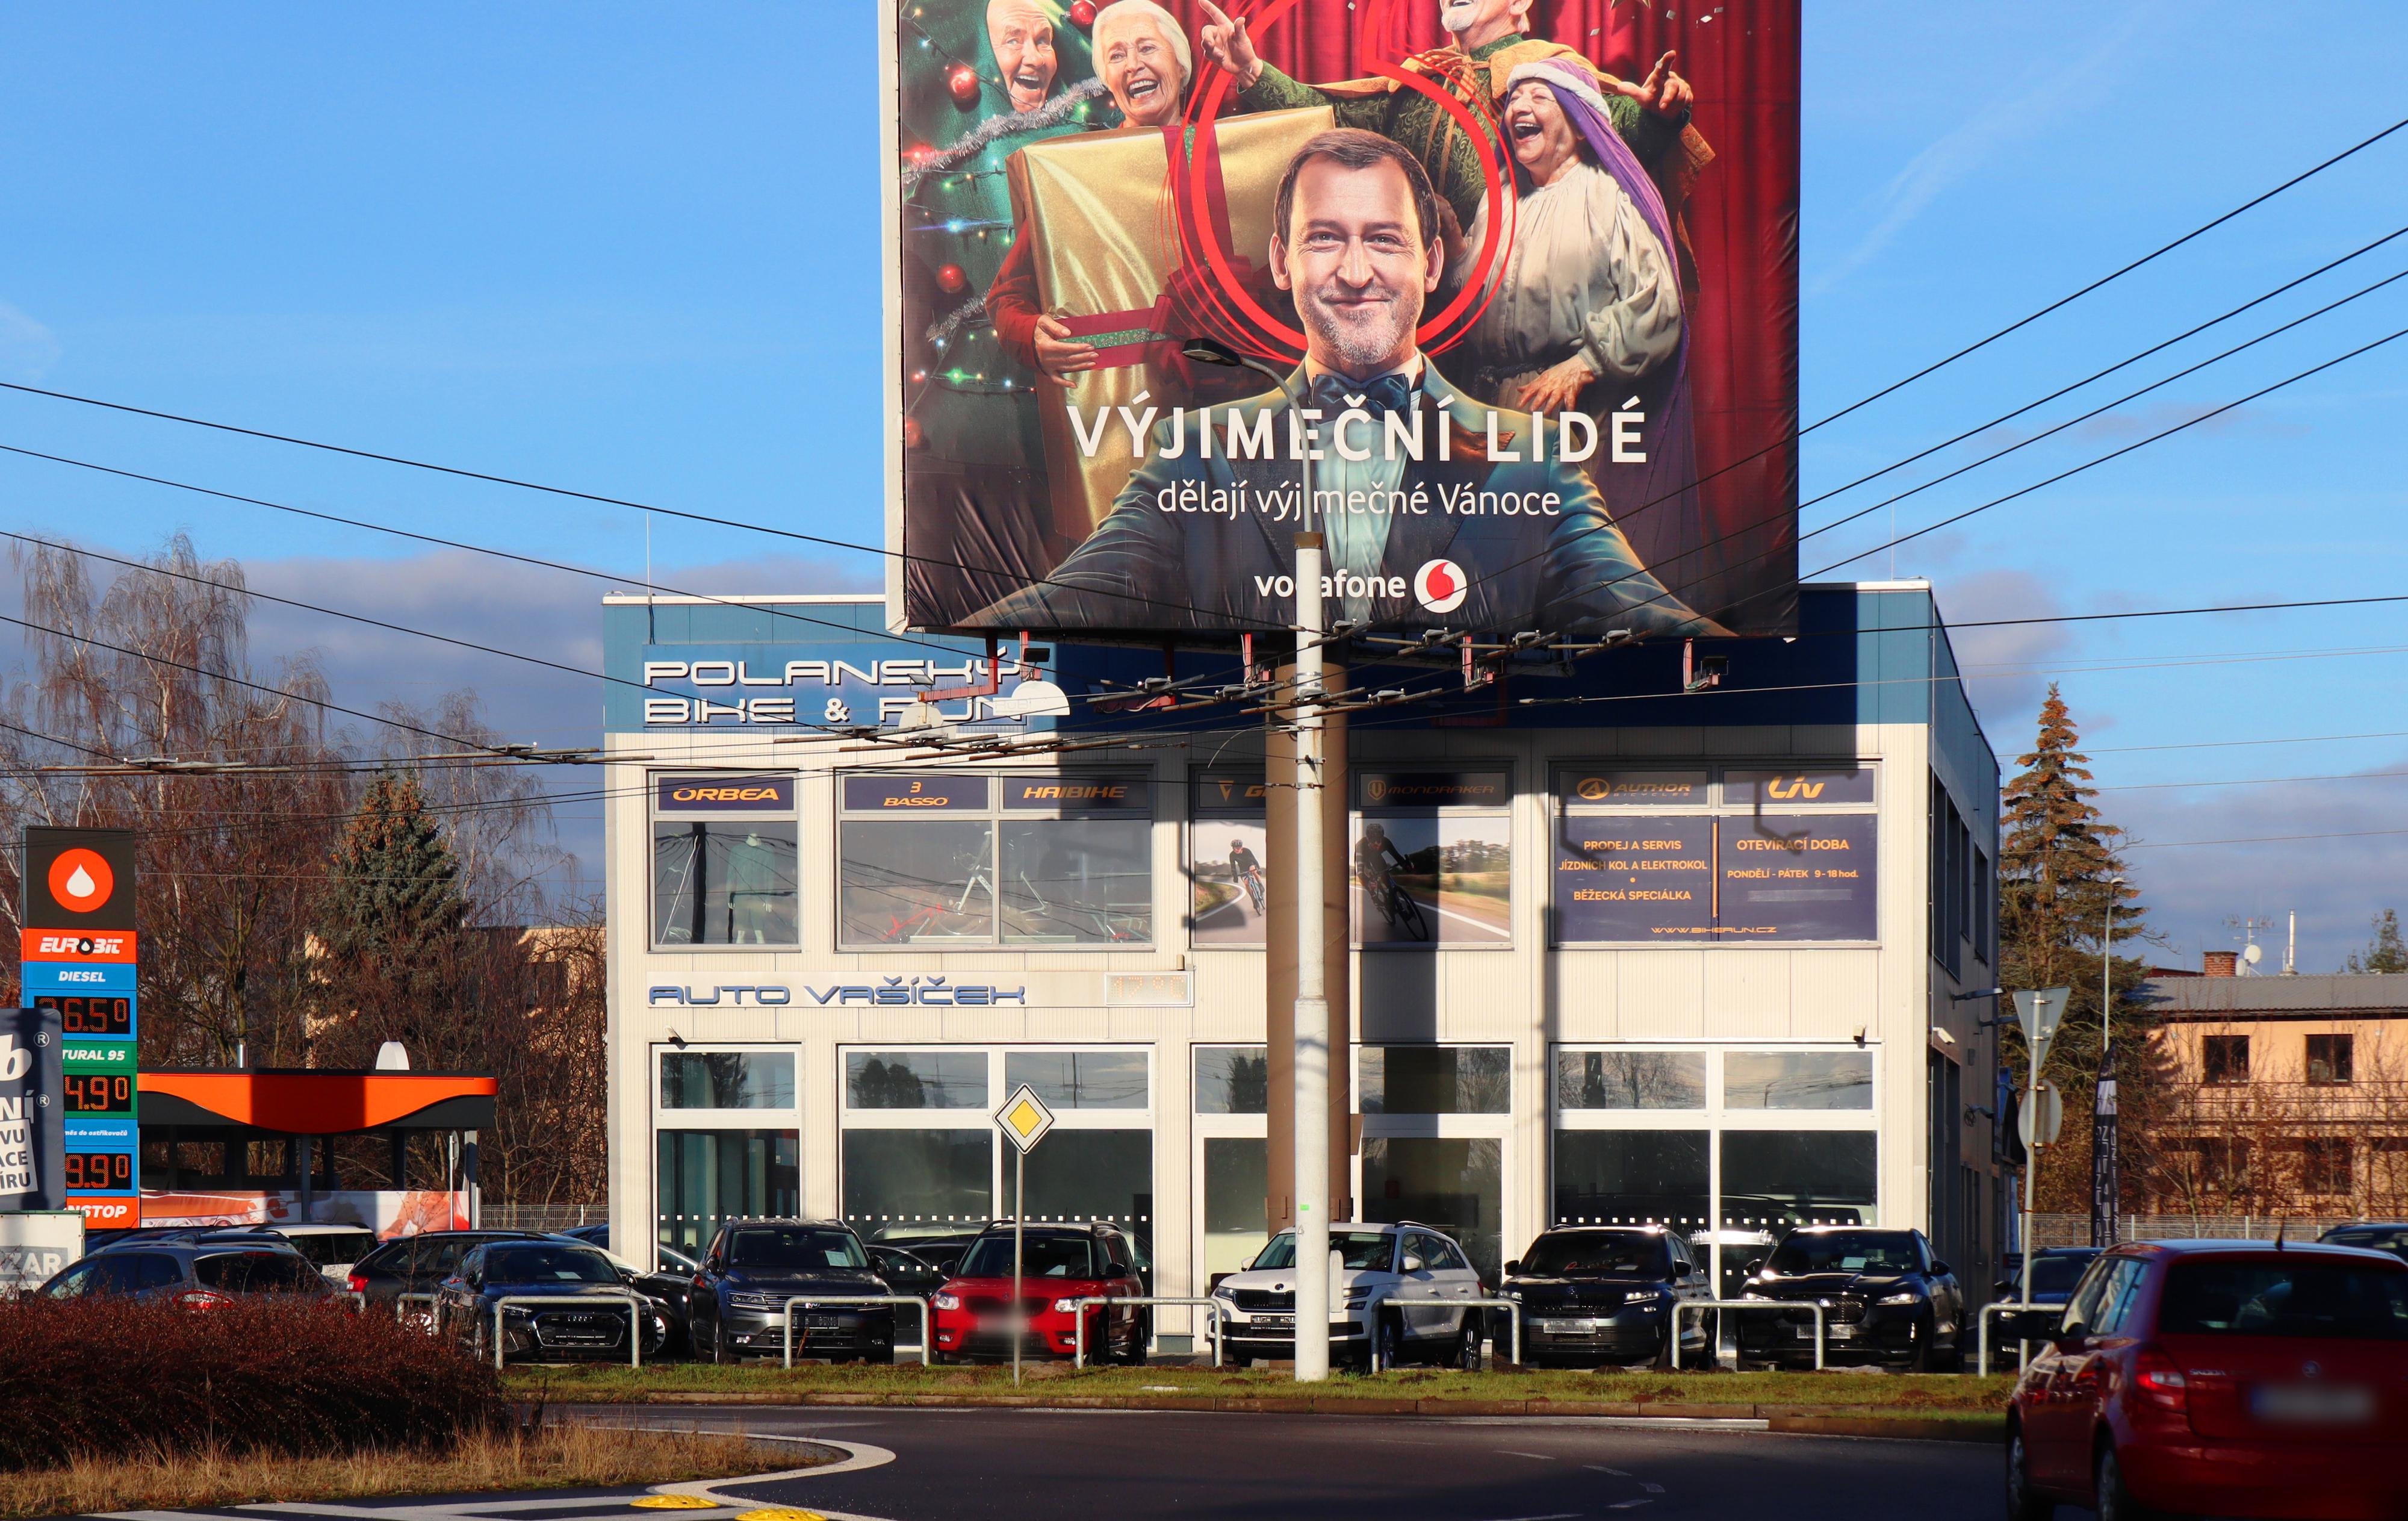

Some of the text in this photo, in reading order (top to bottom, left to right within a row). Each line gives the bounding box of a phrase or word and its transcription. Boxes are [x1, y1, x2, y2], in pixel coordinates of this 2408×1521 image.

[1067, 390, 1646, 462] VÝJIMEČNÍ LIDÉ
[1157, 479, 1560, 521] dělají výjmečné Vánoce
[1254, 568, 1406, 598] voafone
[644, 647, 1022, 686] POLANSKÝ
[644, 698, 795, 723] BIKE
[825, 698, 848, 722] &
[1023, 786, 1128, 798] HAIBIKE
[1614, 783, 1691, 792] AUTHOR
[672, 788, 779, 801] ORBEA
[883, 797, 949, 806] BASSO
[1584, 841, 1682, 850] PRODEJ A SERVIS
[1736, 838, 1850, 851] OTEVÍRACÍ DOBA
[1559, 859, 1708, 871] JÍZDNÍCH KOL A ELEKTROKOL
[1727, 868, 1770, 879] PONDĚLÍ
[1778, 868, 1809, 878] PÁTEK
[1574, 889, 1692, 901] BĚŽECKÁ SPECIÁLKA
[58, 971, 106, 983] DIESEL
[649, 975, 1025, 1005] AUTO VAŠÍČEK
[107, 1050, 126, 1062] 95
